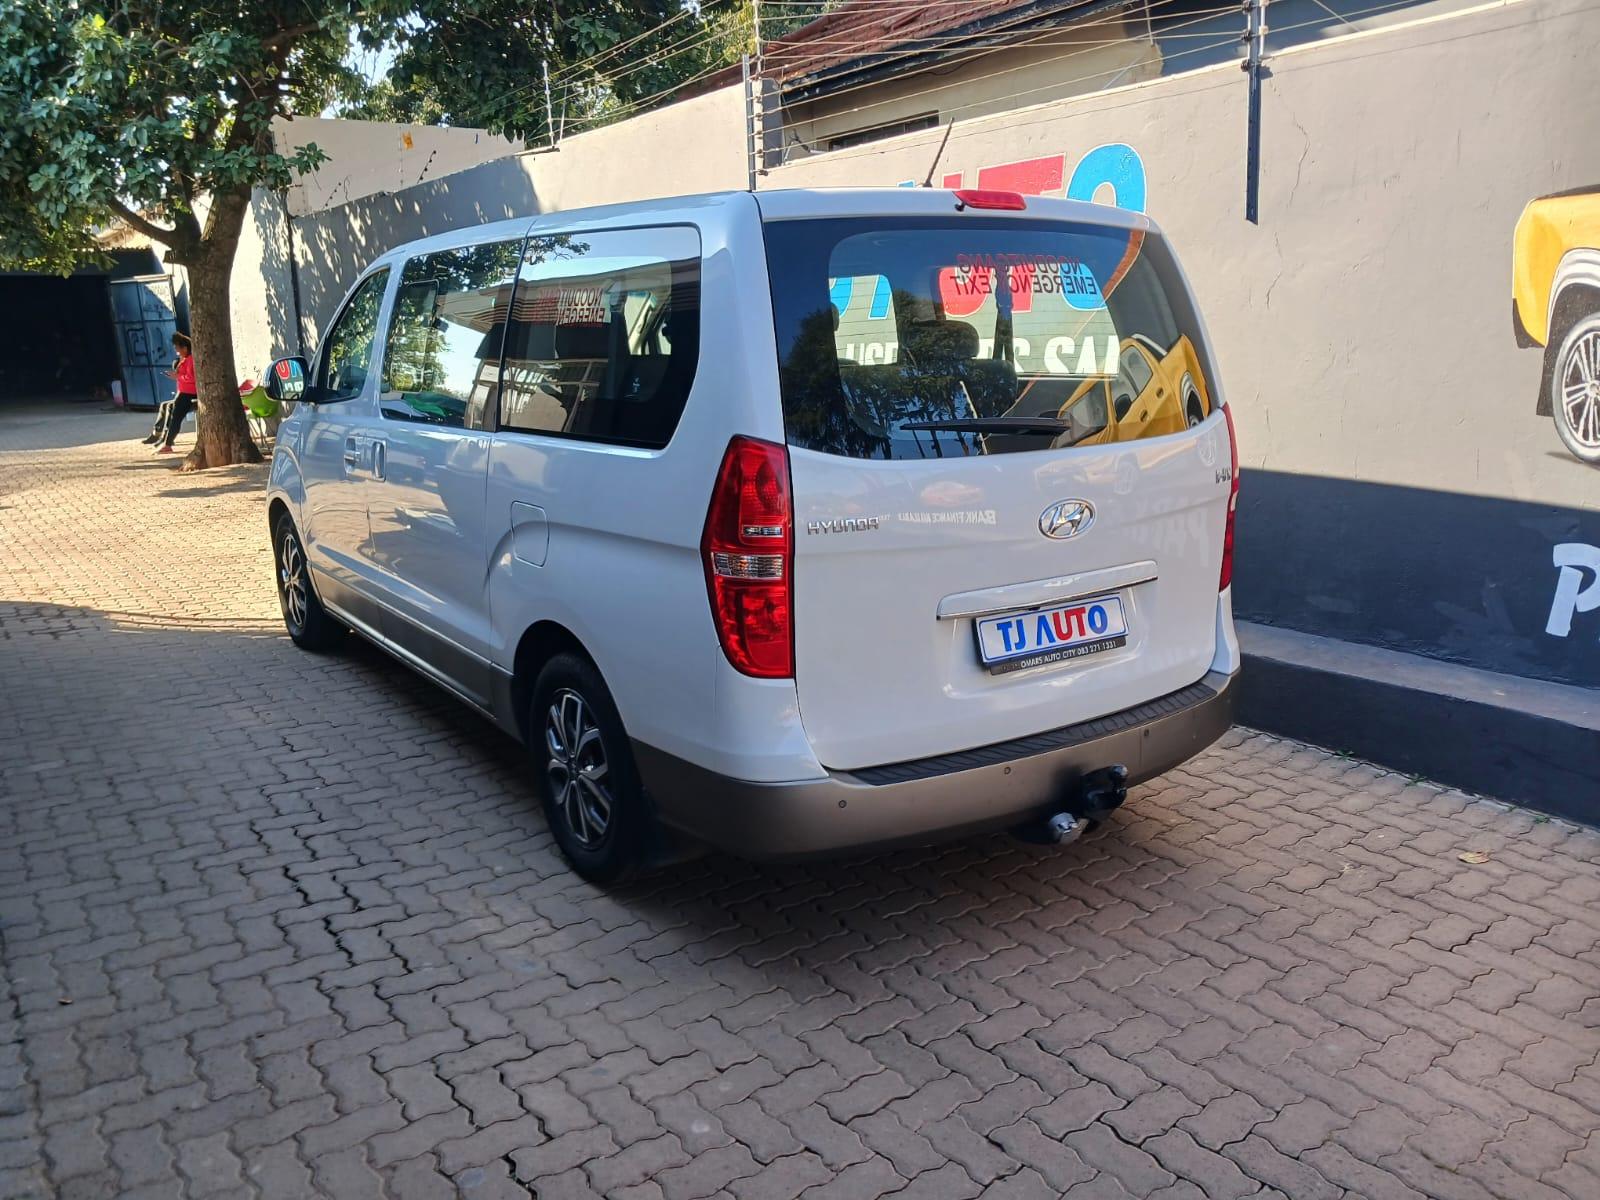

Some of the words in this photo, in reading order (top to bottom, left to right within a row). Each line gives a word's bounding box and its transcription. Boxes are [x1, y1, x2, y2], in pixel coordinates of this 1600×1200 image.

[996, 618, 1027, 652] TJ
[1035, 603, 1108, 647] AUTO
[1044, 652, 1061, 663] AUTO
[1062, 648, 1076, 659] CITY
[1089, 642, 1101, 653] 271
